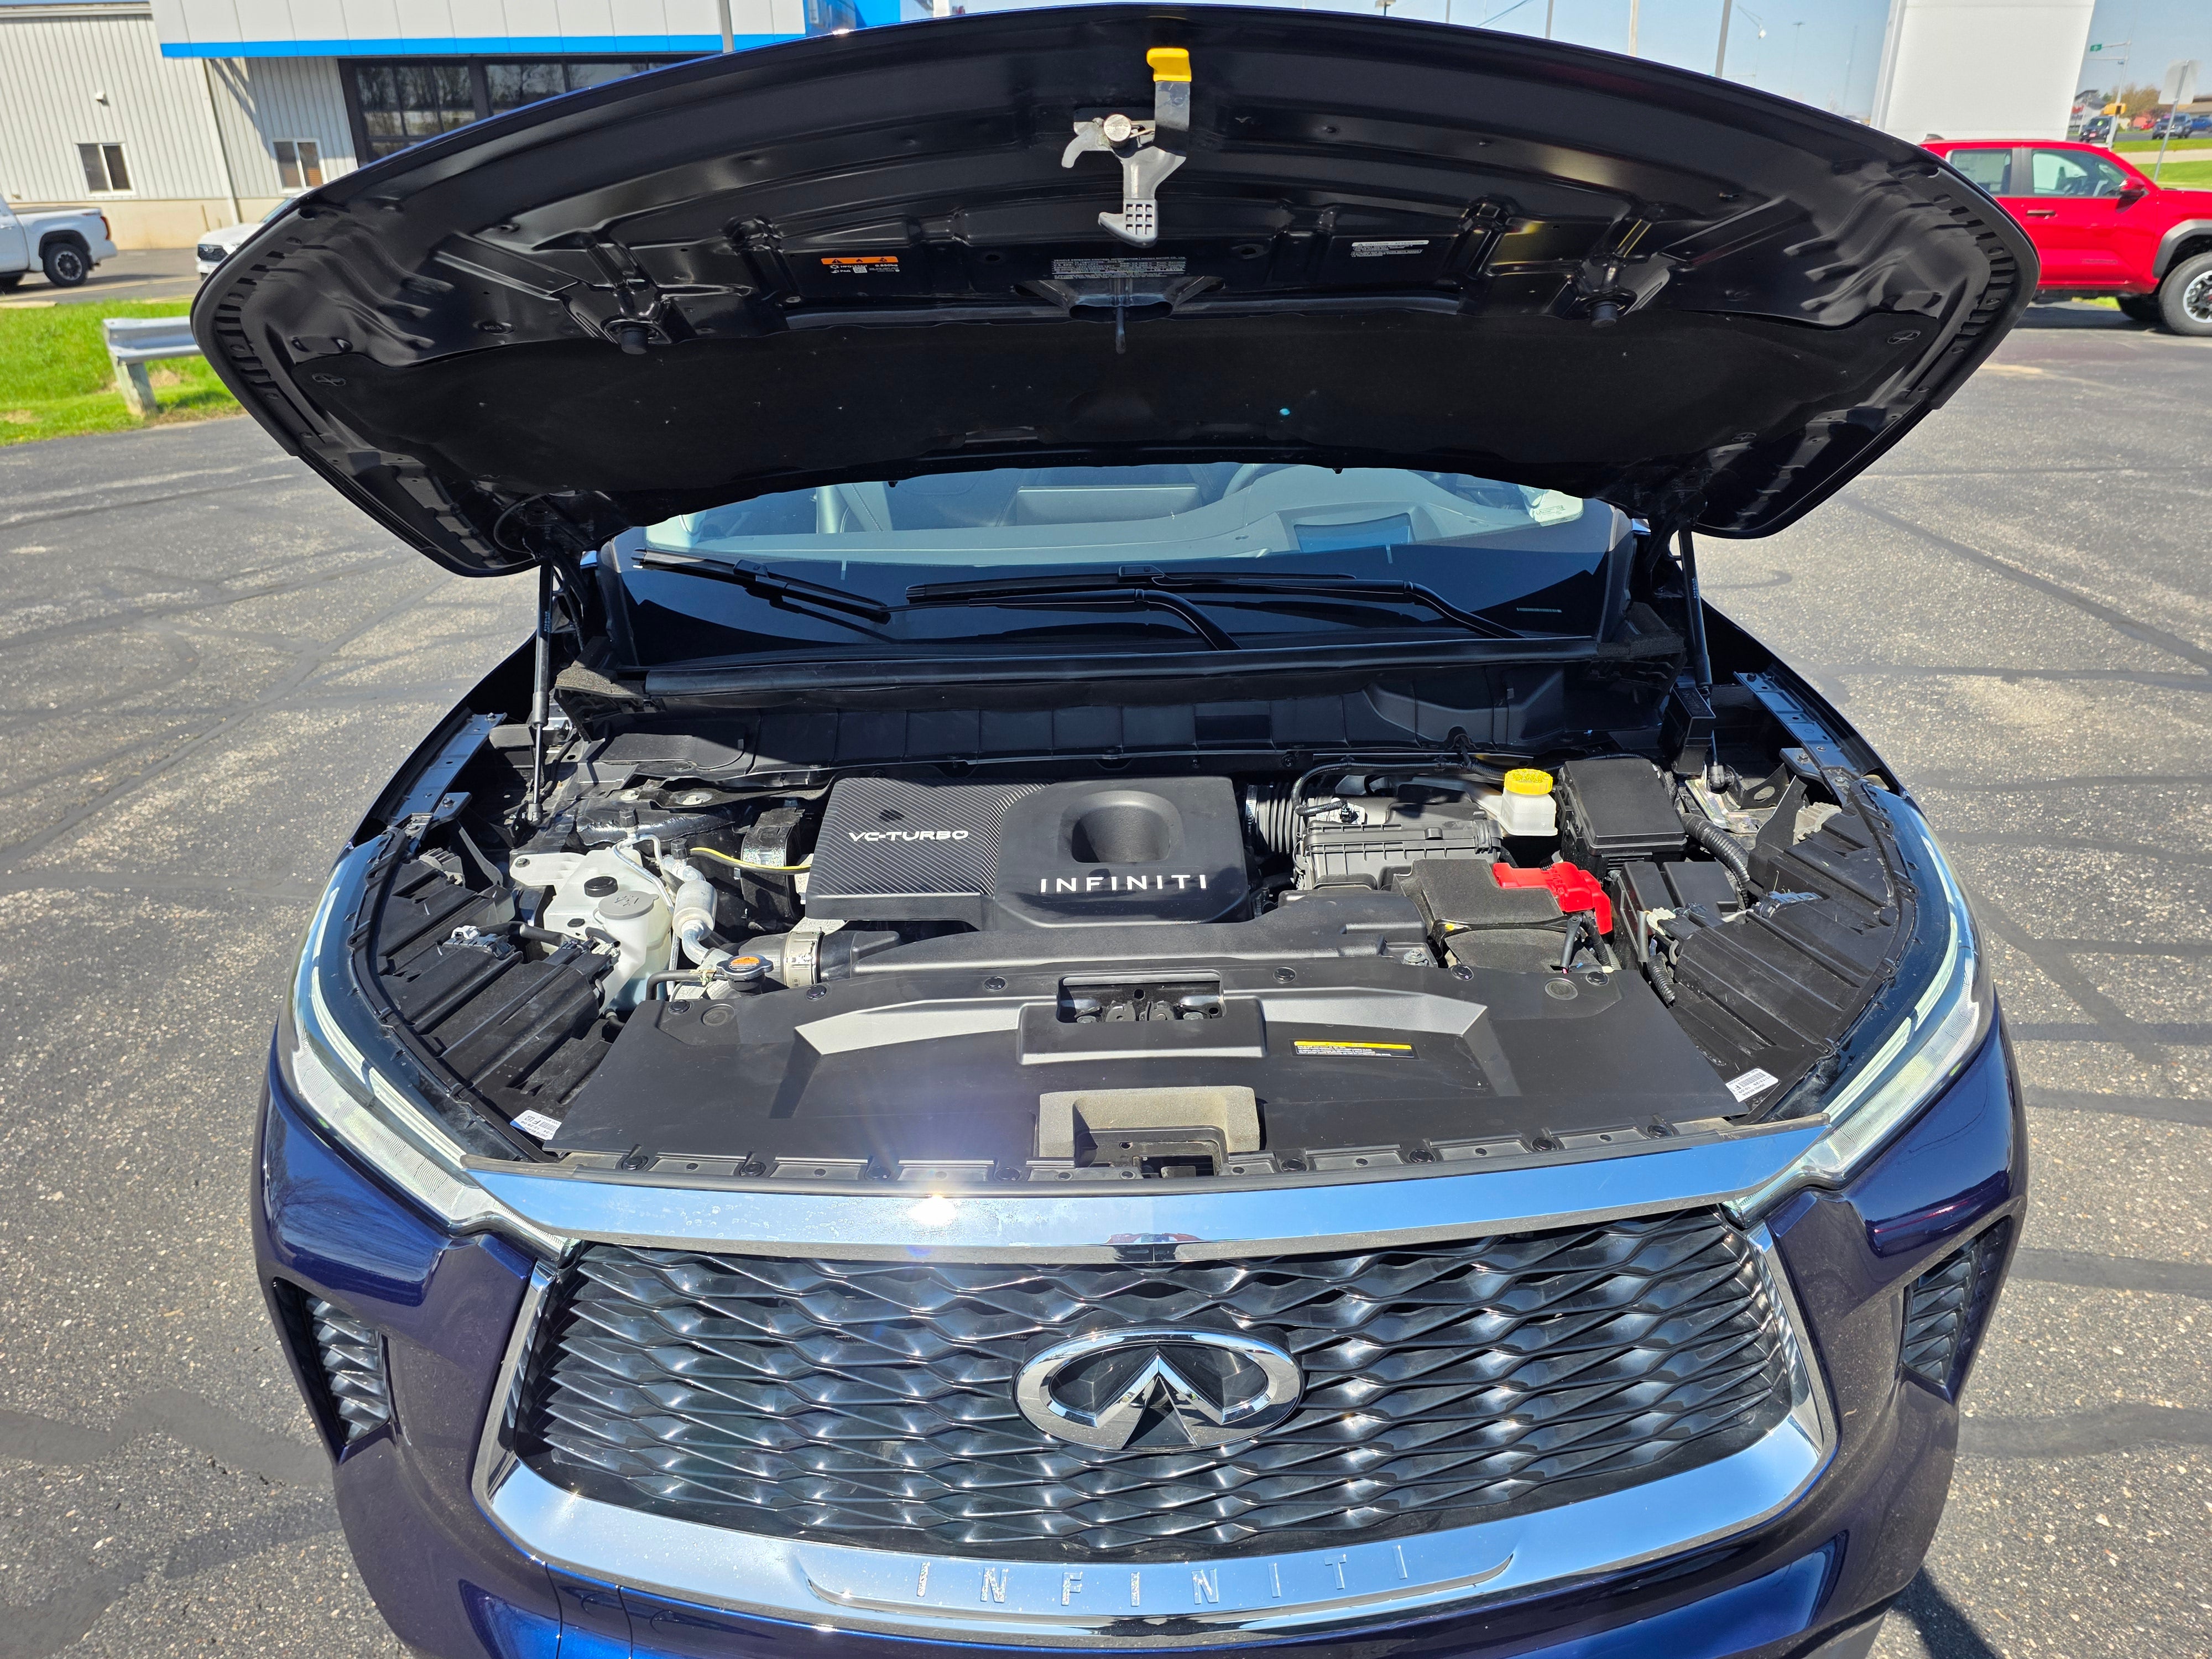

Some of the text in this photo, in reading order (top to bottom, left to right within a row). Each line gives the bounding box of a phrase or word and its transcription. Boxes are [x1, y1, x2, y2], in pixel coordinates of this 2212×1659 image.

[848, 830, 968, 841] VC-TURBO
[1040, 874, 1207, 893] INFINITI
[916, 1545, 1408, 1607] INFINITI
